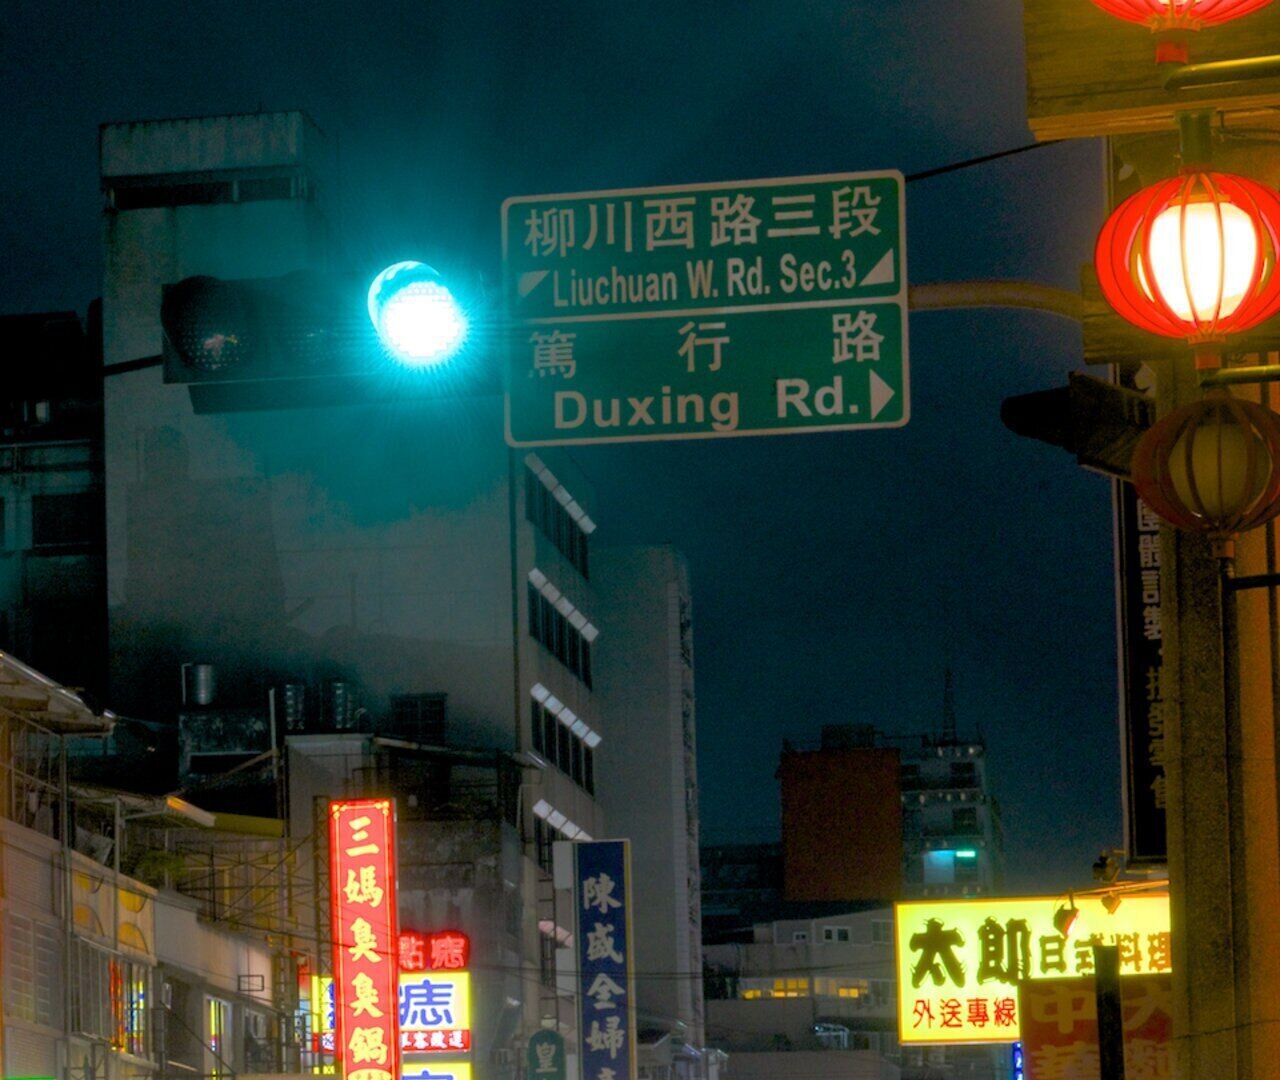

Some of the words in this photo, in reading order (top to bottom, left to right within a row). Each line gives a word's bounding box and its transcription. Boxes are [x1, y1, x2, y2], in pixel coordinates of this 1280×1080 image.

[524, 185, 882, 258] 柳川西路三段
[553, 266, 678, 308] Liuchuan
[686, 259, 719, 300] W.
[727, 256, 771, 296] Rd.
[779, 249, 857, 293] Sec.3
[527, 310, 885, 380] 篤行路
[553, 385, 740, 433] Duxing
[775, 376, 859, 419] Rd.
[343, 815, 389, 1065] 三媽臭臭鍋
[909, 915, 1032, 989] 太郎
[912, 997, 1018, 1029] 外送專線
